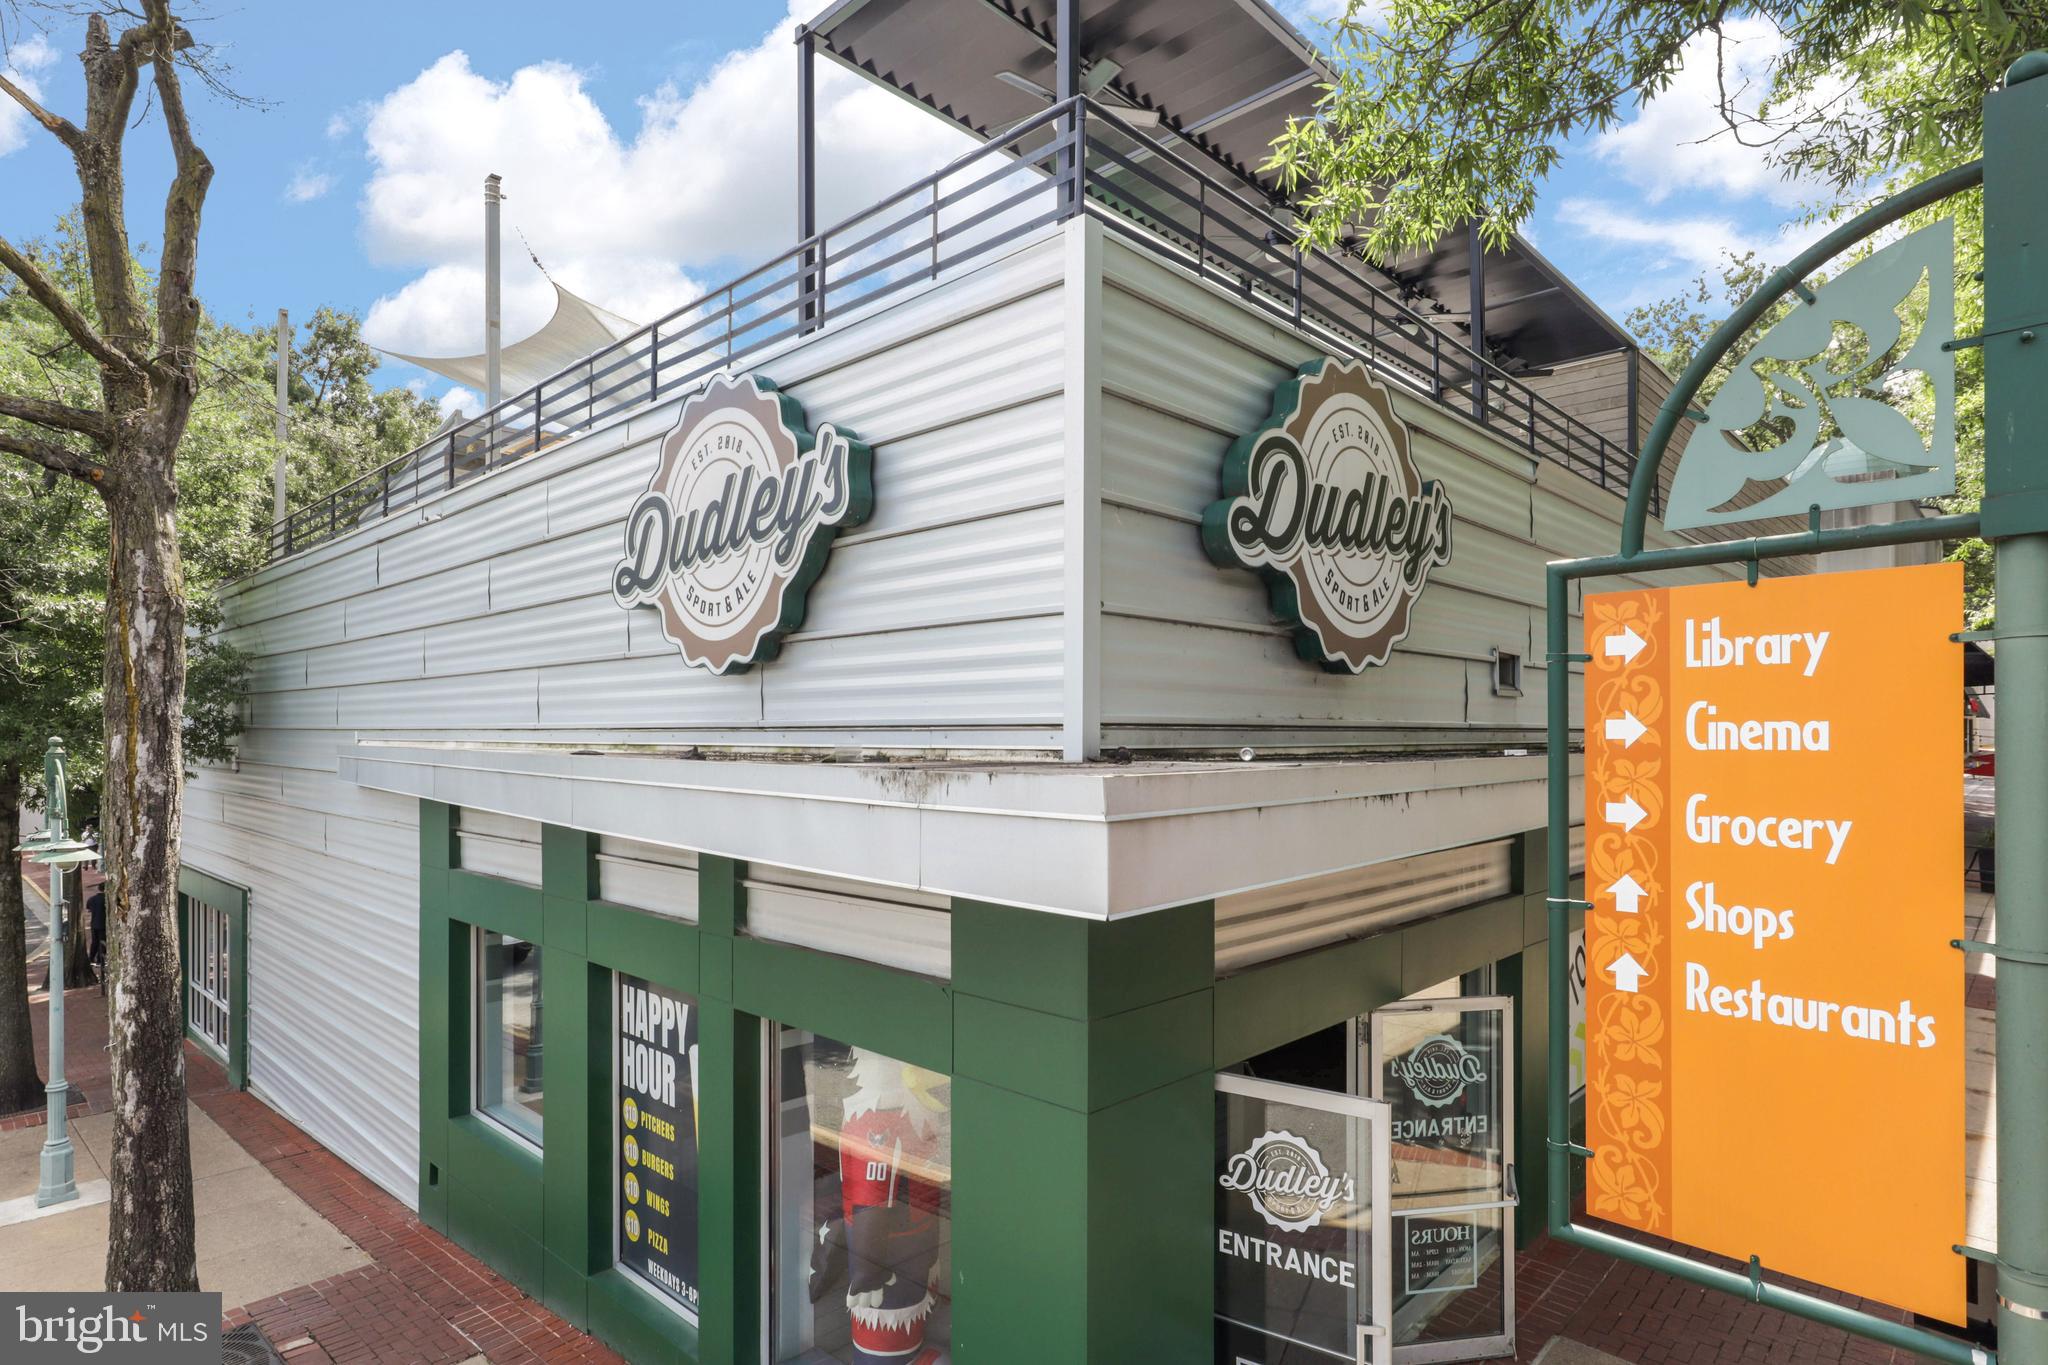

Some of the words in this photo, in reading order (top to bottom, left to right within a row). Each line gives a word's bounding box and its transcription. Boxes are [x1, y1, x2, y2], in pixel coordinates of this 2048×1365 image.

[691, 443, 713, 471] EST.
[1332, 422, 1354, 443] EST.
[616, 431, 845, 598] Dudley's
[1231, 436, 1450, 585] Dudley's
[686, 585, 721, 617] SPORT
[724, 595, 733, 613] &
[735, 570, 757, 605] ALE
[1324, 568, 1360, 613] SPORT
[1362, 594, 1370, 613] &
[1372, 577, 1390, 607] ALE
[1685, 616, 1830, 677] Library
[1685, 701, 1830, 751] Cinema
[1685, 793, 1853, 865] Grocery
[1685, 881, 1795, 950] Shops
[622, 984, 689, 1055] HAPPY
[1685, 961, 1937, 1049] Restaurants
[622, 1036, 676, 1108] HOUR
[640, 1110, 675, 1143] PITCHERS
[641, 1149, 674, 1181] BURGERS
[866, 1162, 887, 1181] 00
[1219, 1153, 1355, 1209] Dudley's
[646, 1188, 670, 1217] WINGS
[647, 1228, 669, 1256] PIZZA
[1219, 1229, 1355, 1288] ENTRANCE
[647, 1258, 680, 1293] WEEKDAYS
